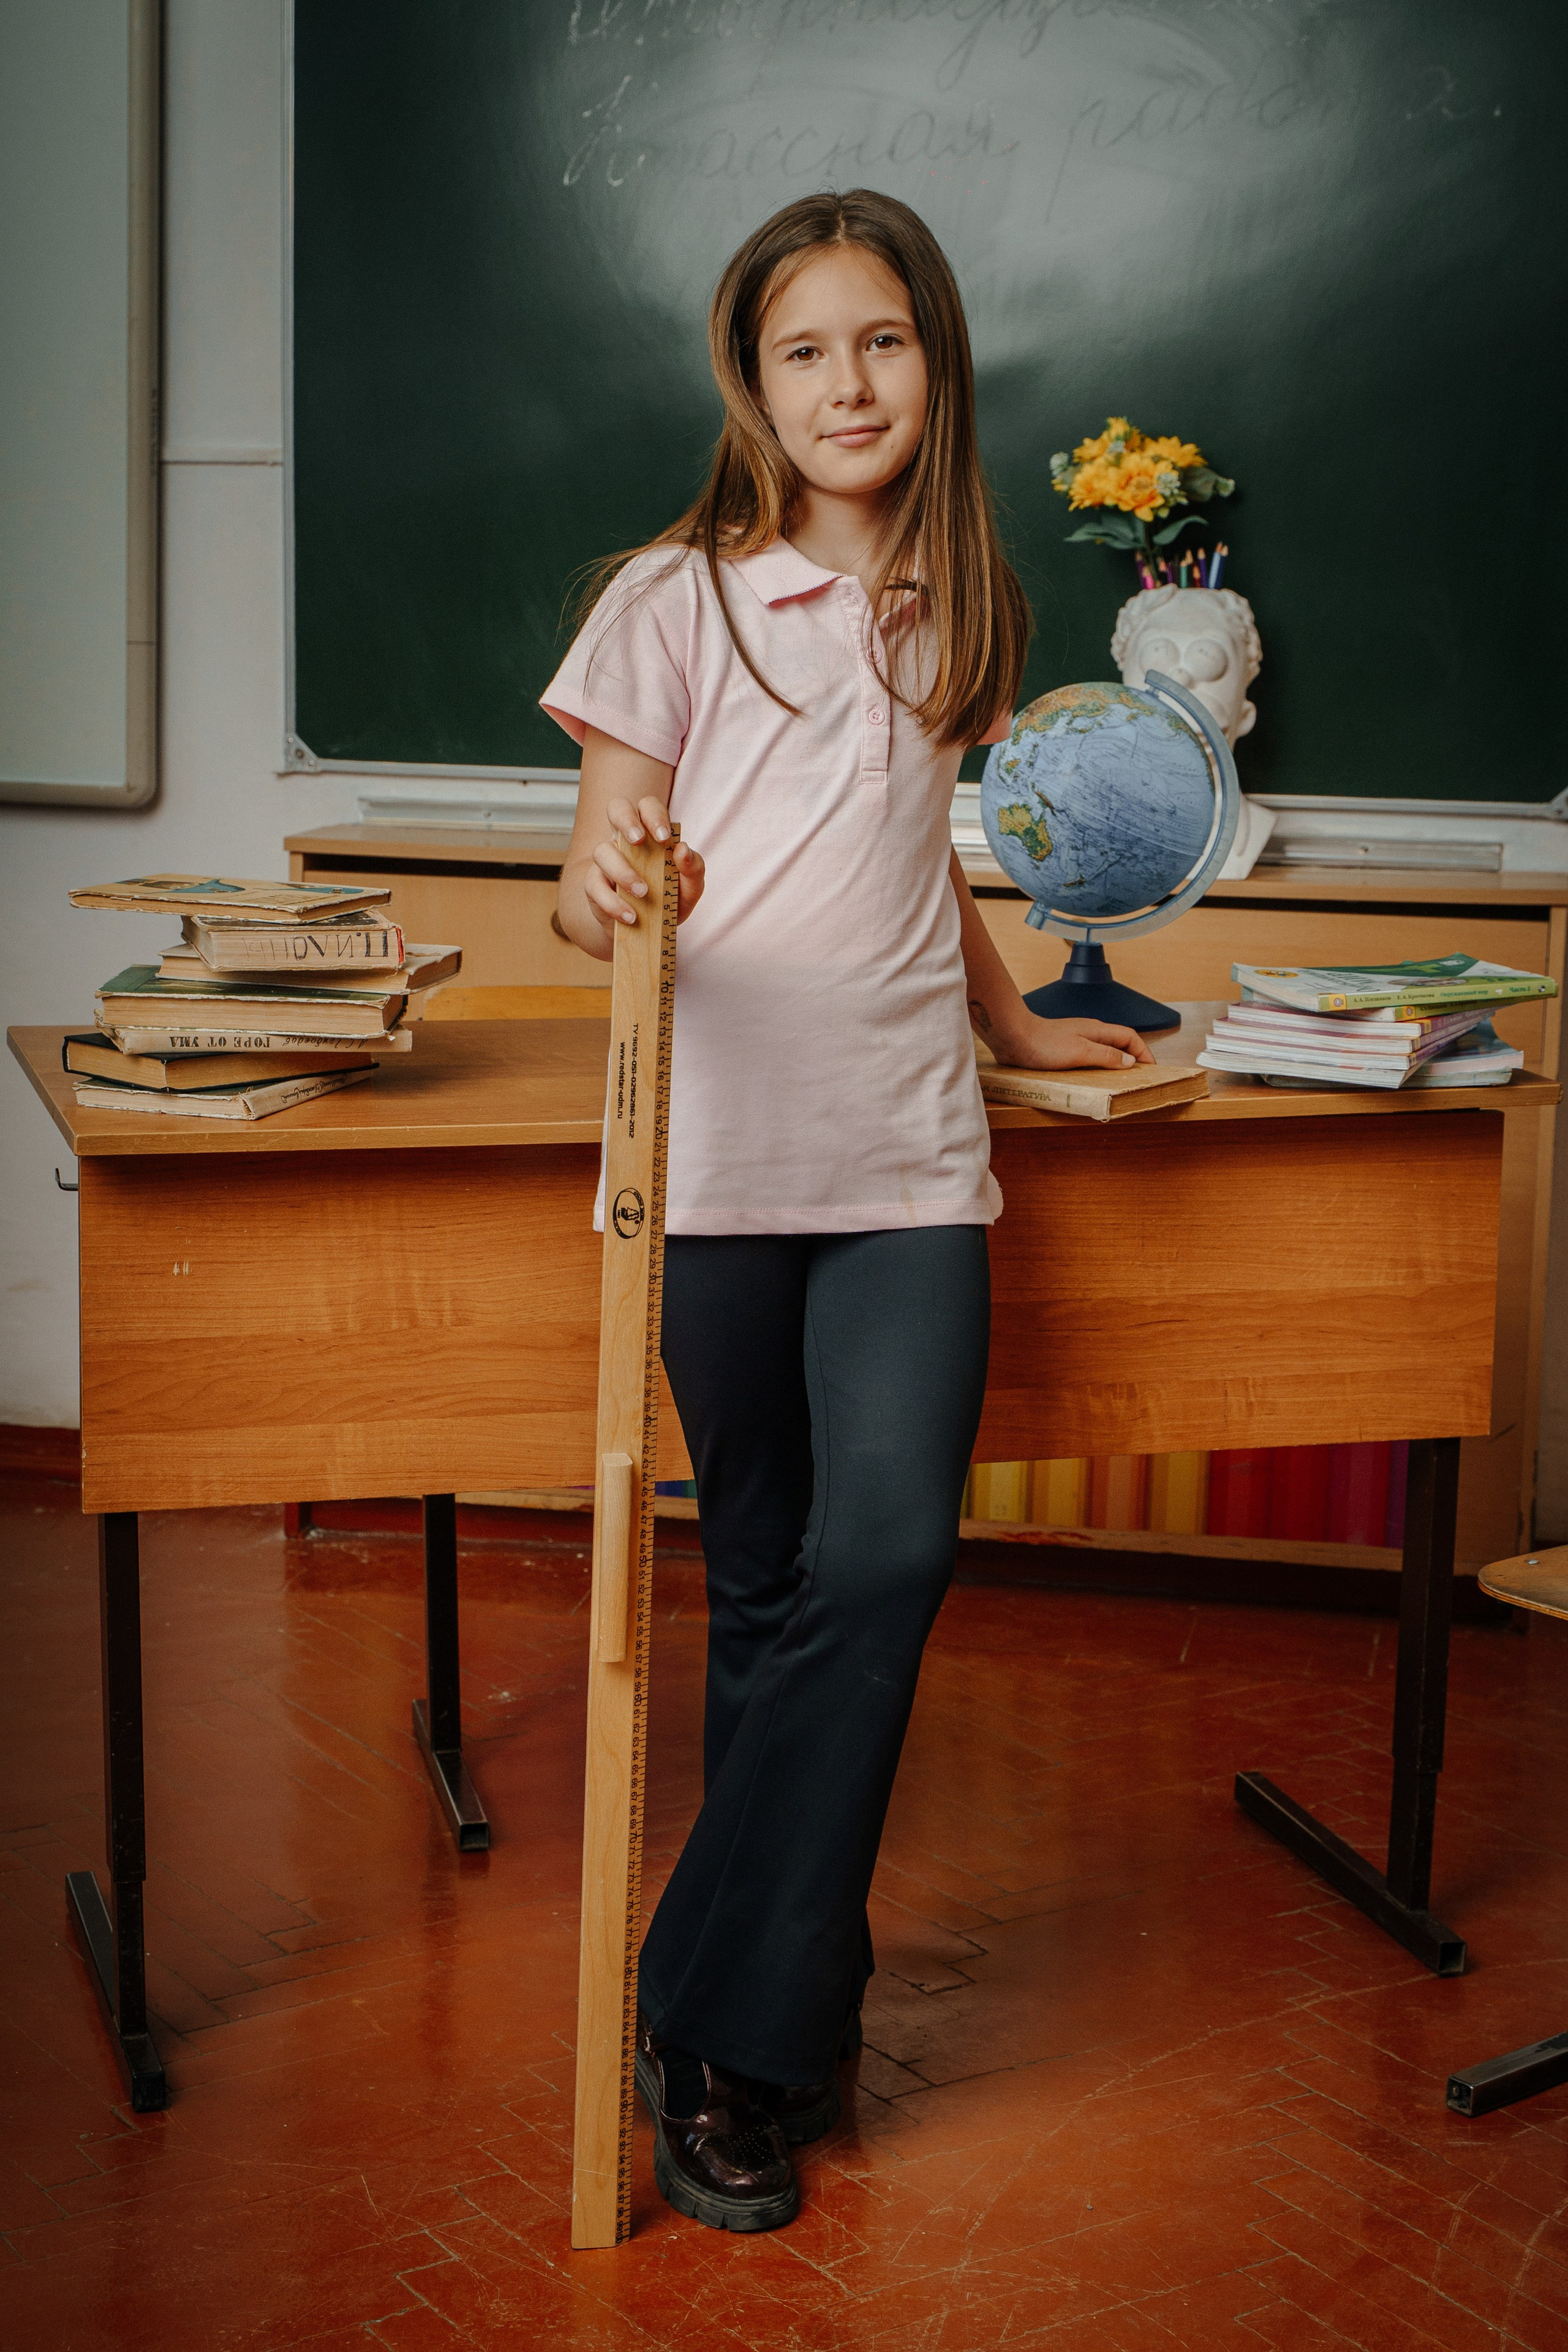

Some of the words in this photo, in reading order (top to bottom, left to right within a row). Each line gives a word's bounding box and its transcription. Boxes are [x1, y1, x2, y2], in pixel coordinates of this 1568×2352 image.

[660, 981, 668, 993] 10
[660, 996, 666, 1005] 11
[659, 1011, 666, 1022] 12
[658, 1026, 666, 1036] 13
[169, 1036, 199, 1048] УМА
[207, 1036, 227, 1048] ОТ
[233, 1036, 271, 1048] ГОРЕ
[658, 1041, 665, 1051] 14
[657, 1055, 665, 1066] 15
[617, 1042, 626, 1119] www.redstar-udm.ru
[657, 1071, 664, 1080] 16
[656, 1085, 663, 1095] 17
[992, 1087, 1052, 1101] ЛИТЕРАТУРА
[655, 1099, 663, 1110] 18
[655, 1115, 662, 1125] 19
[655, 1127, 663, 1139] 20
[654, 1142, 661, 1152] 21
[654, 1157, 660, 1167] 22
[653, 1172, 660, 1182] 23
[652, 1186, 659, 1196] 24
[652, 1200, 658, 1211] 25
[651, 1215, 658, 1226] 26
[650, 1230, 657, 1240] 27
[650, 1244, 657, 1254] 28
[649, 1258, 657, 1269] 29
[649, 1272, 657, 1284] 30
[649, 1287, 655, 1297] 31
[648, 1302, 655, 1312] 32
[647, 1316, 654, 1327] 33
[647, 1330, 654, 1341] 34
[646, 1344, 653, 1355] 35
[646, 1359, 653, 1370] 36
[645, 1373, 652, 1384] 37
[644, 1387, 652, 1398] 38
[644, 1401, 651, 1412] 39
[644, 1415, 652, 1427] 40
[643, 1430, 650, 1439] 41
[643, 1444, 649, 1455] 42
[642, 1458, 649, 1469] 43
[641, 1472, 649, 1482] 44
[641, 1487, 648, 1497] 45
[641, 1501, 647, 1510] 46
[640, 1515, 647, 1525] 47
[639, 1529, 646, 1539] 48
[639, 1543, 646, 1553] 49
[638, 1555, 646, 1567] 50
[638, 1570, 645, 1580] 51
[638, 1585, 644, 1595] 52
[637, 1599, 644, 1608] 53
[636, 1612, 643, 1622] 54
[636, 1626, 643, 1637] 55
[635, 1640, 643, 1650] 56
[635, 1654, 642, 1664] 57
[635, 1668, 641, 1678] 58
[634, 1682, 641, 1692] 59
[633, 1694, 641, 1706] 60
[633, 1709, 640, 1719] 61
[633, 1723, 639, 1733] 62
[632, 1737, 639, 1747] 63
[631, 1751, 638, 1761] 64
[631, 1765, 638, 1775] 65
[630, 1778, 638, 1789] 66
[630, 1792, 637, 1801] 67
[630, 1805, 636, 1815] 68
[629, 1819, 636, 1829] 69
[628, 1831, 636, 1843] 70
[628, 1845, 635, 1855] 71
[628, 1859, 635, 1870] 72
[627, 1872, 634, 1883] 73
[627, 1886, 634, 1897] 74
[627, 1899, 633, 1910] 75
[626, 1913, 633, 1924] 76
[625, 1927, 632, 1937] 77
[625, 1940, 632, 1951] 78
[625, 1954, 631, 1965] 79
[624, 1967, 632, 1979] 80
[624, 1981, 630, 1991] 81
[623, 1995, 630, 2005] 82
[623, 2008, 630, 2019] 83
[622, 2021, 629, 2032] 84
[622, 2035, 628, 2046] 85
[622, 2048, 628, 2059] 86
[621, 2062, 628, 2071] 87
[620, 2075, 627, 2086] 88
[620, 2089, 627, 2098] 89
[620, 2100, 628, 2113] 90
[619, 2114, 626, 2124] 91
[619, 2128, 626, 2139] 92
[619, 2141, 625, 2152] 93
[618, 2154, 625, 2165] 94
[617, 2168, 624, 2178] 95
[617, 2181, 624, 2192] 96
[617, 2194, 624, 2204] 97
[616, 2207, 623, 2218] 98
[616, 2220, 623, 2231] 99
